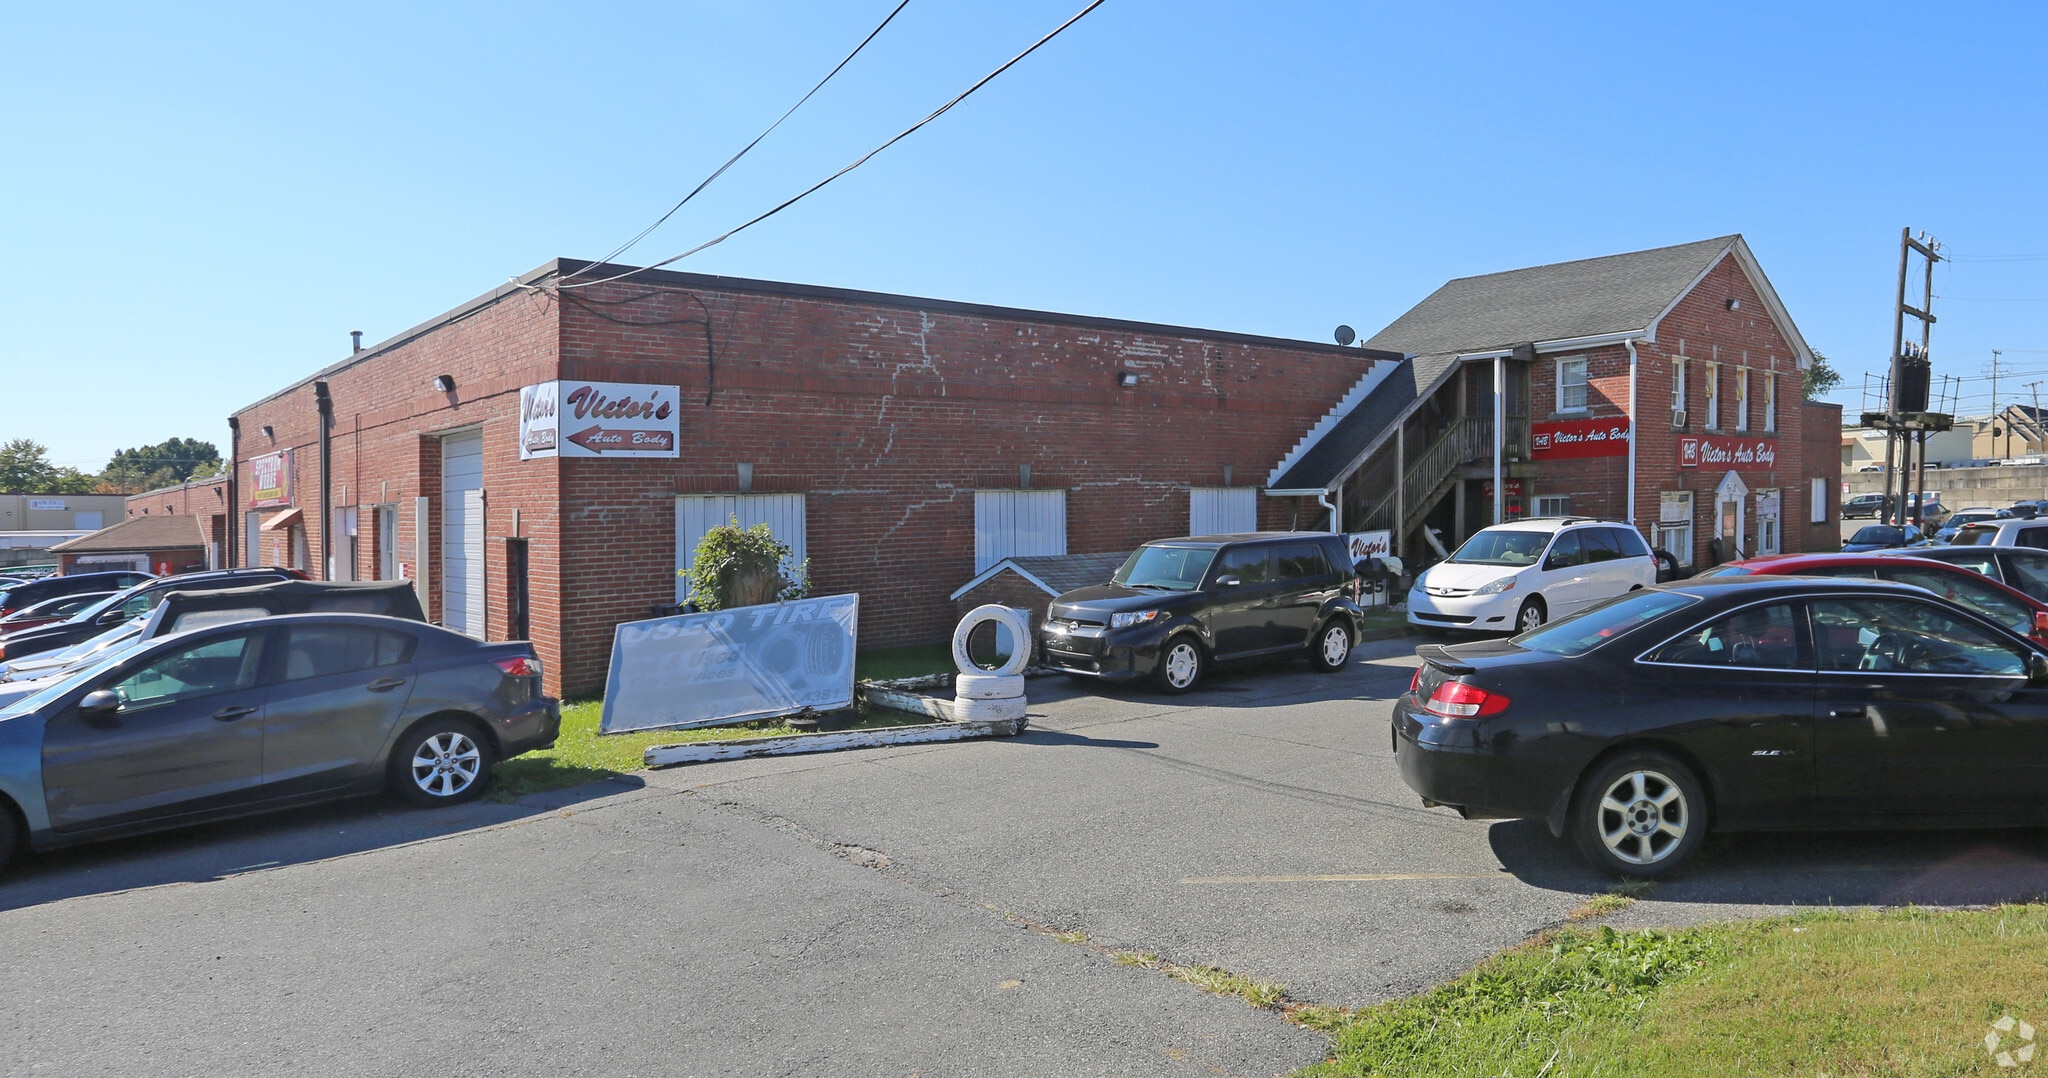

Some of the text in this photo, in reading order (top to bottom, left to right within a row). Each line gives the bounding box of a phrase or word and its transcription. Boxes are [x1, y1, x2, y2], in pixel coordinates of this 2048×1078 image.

[522, 387, 557, 424] Victor's
[567, 385, 673, 421] Victor's
[527, 430, 555, 446] Auto Body
[586, 431, 668, 447] Auto Body
[1554, 430, 1583, 443] Victor's
[1585, 428, 1607, 442] Auto
[1609, 427, 1632, 442] Body
[1700, 440, 1732, 464] Victor's
[1733, 443, 1754, 464] Auto
[1756, 442, 1775, 468] Body
[1351, 536, 1388, 558] Victor's
[621, 597, 847, 645] USED TIRE
